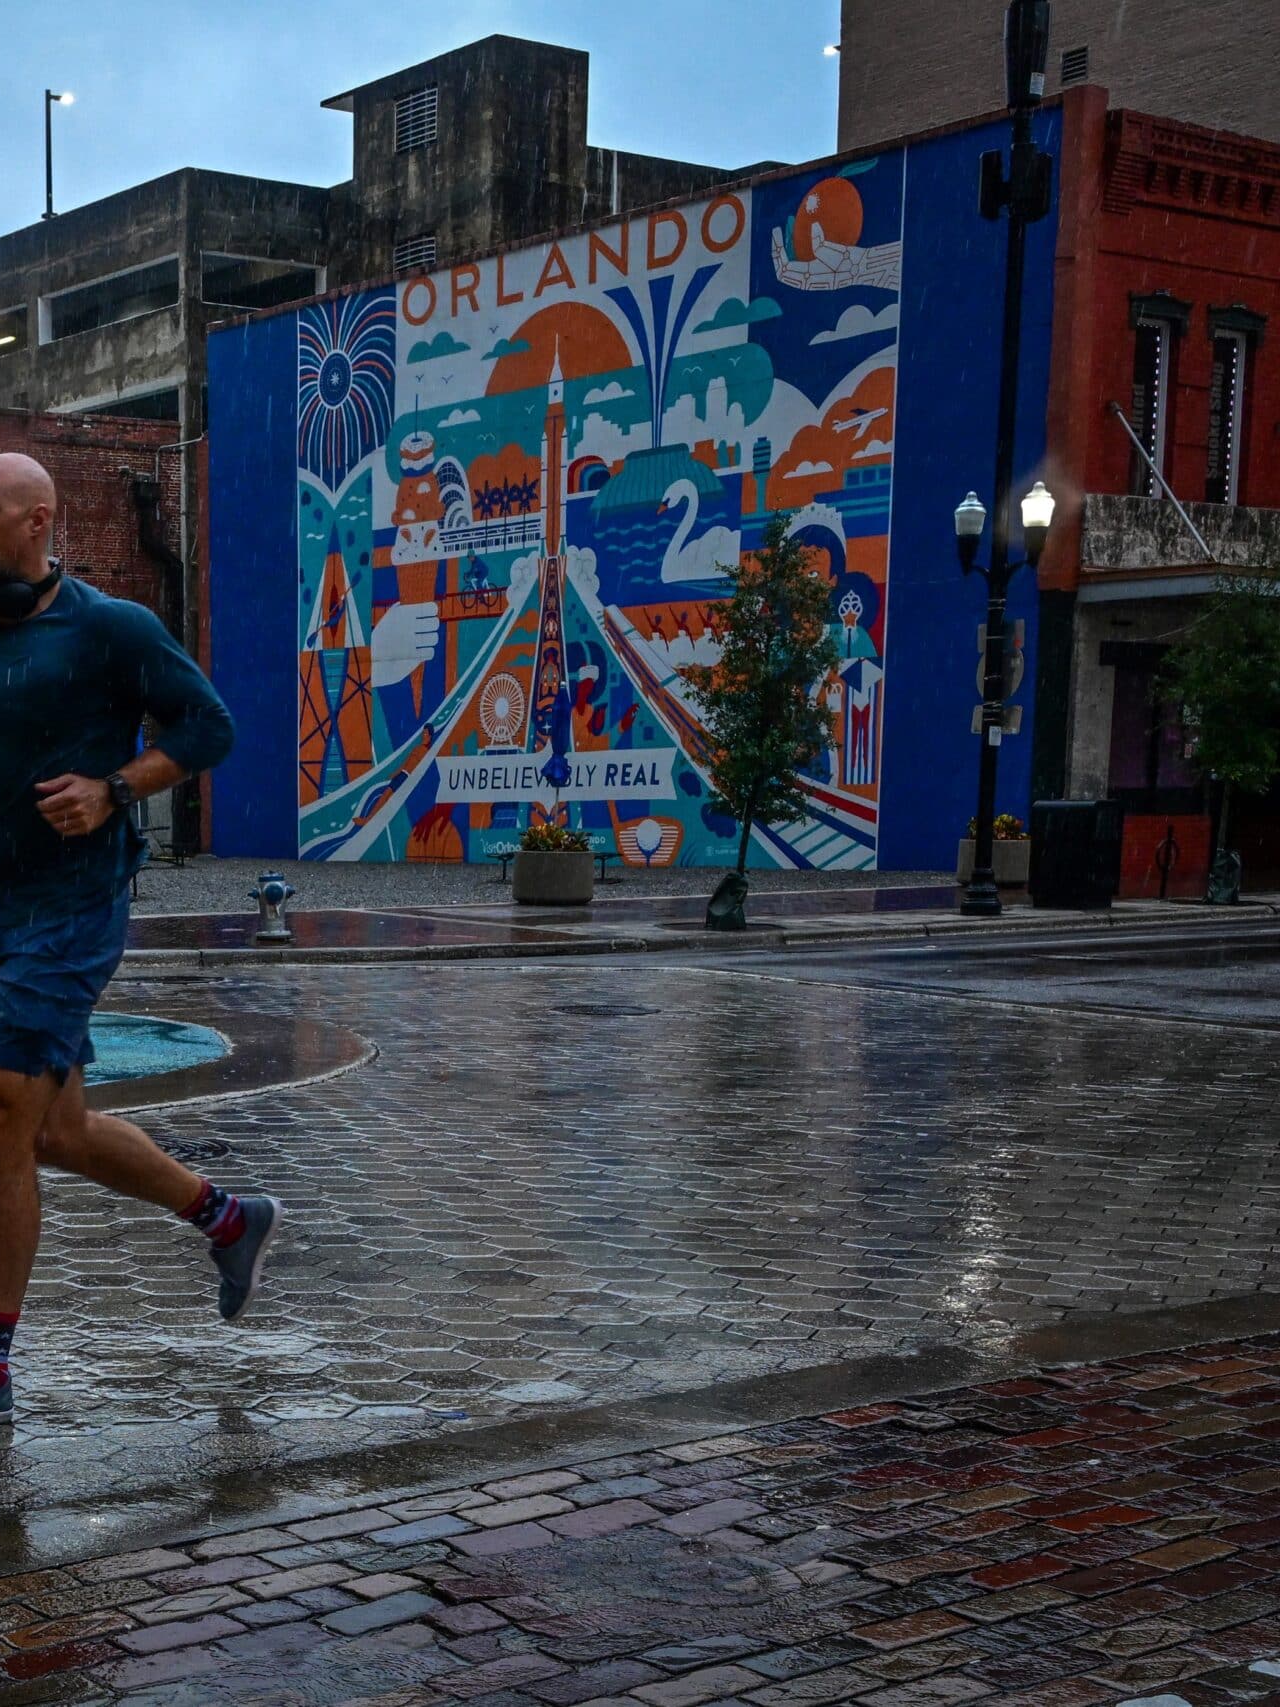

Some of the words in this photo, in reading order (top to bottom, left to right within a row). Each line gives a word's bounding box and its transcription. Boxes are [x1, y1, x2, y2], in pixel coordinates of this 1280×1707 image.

[402, 193, 746, 326] ORLANDO
[448, 764, 597, 790] UNBELIEVBLY
[604, 762, 660, 787] REAL
